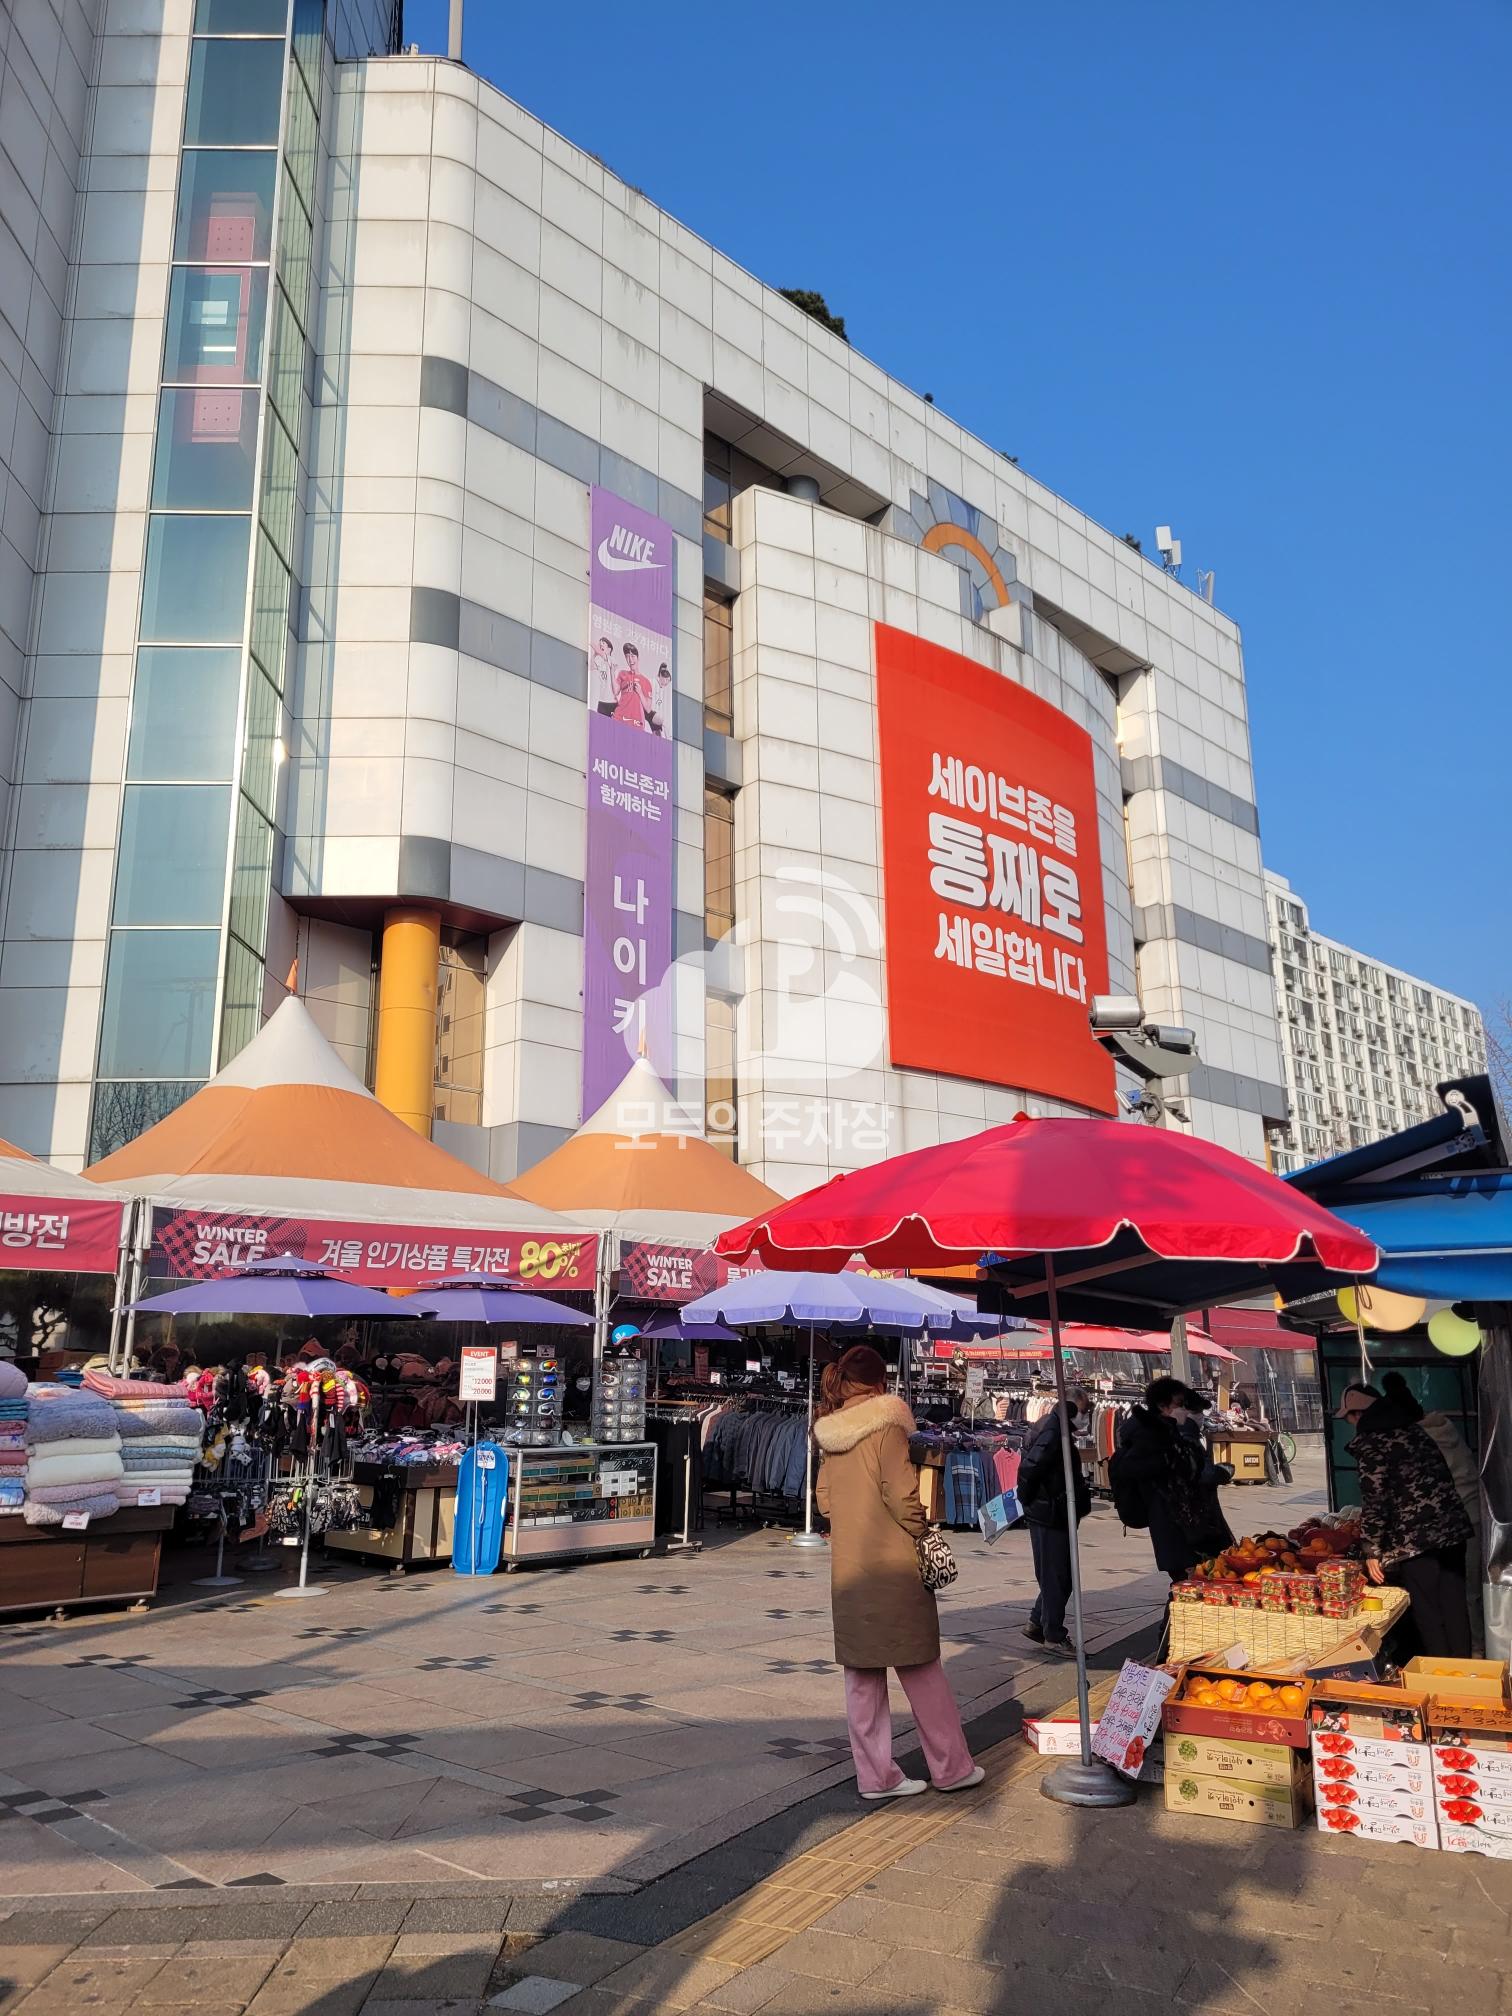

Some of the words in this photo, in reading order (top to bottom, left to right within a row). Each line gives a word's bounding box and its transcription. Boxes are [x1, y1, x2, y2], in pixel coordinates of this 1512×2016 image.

[609, 524, 655, 562] NIKE
[592, 757, 669, 800] 세이브존과
[600, 784, 662, 821] 함께하는
[928, 752, 1077, 857] 세이브존을
[928, 812, 1083, 943] 통째로
[611, 875, 649, 1042] 나이키
[934, 912, 1087, 1004] 세일합니다
[0, 1212, 69, 1249] 방전
[196, 1224, 267, 1244] WINTER
[192, 1242, 265, 1266] SALE
[318, 1240, 363, 1268] 겨울
[367, 1241, 448, 1271] 인기상품
[451, 1247, 509, 1272] 특가전
[519, 1241, 579, 1279] 80%
[646, 1254, 693, 1270] WINTER
[646, 1268, 692, 1289] SALE
